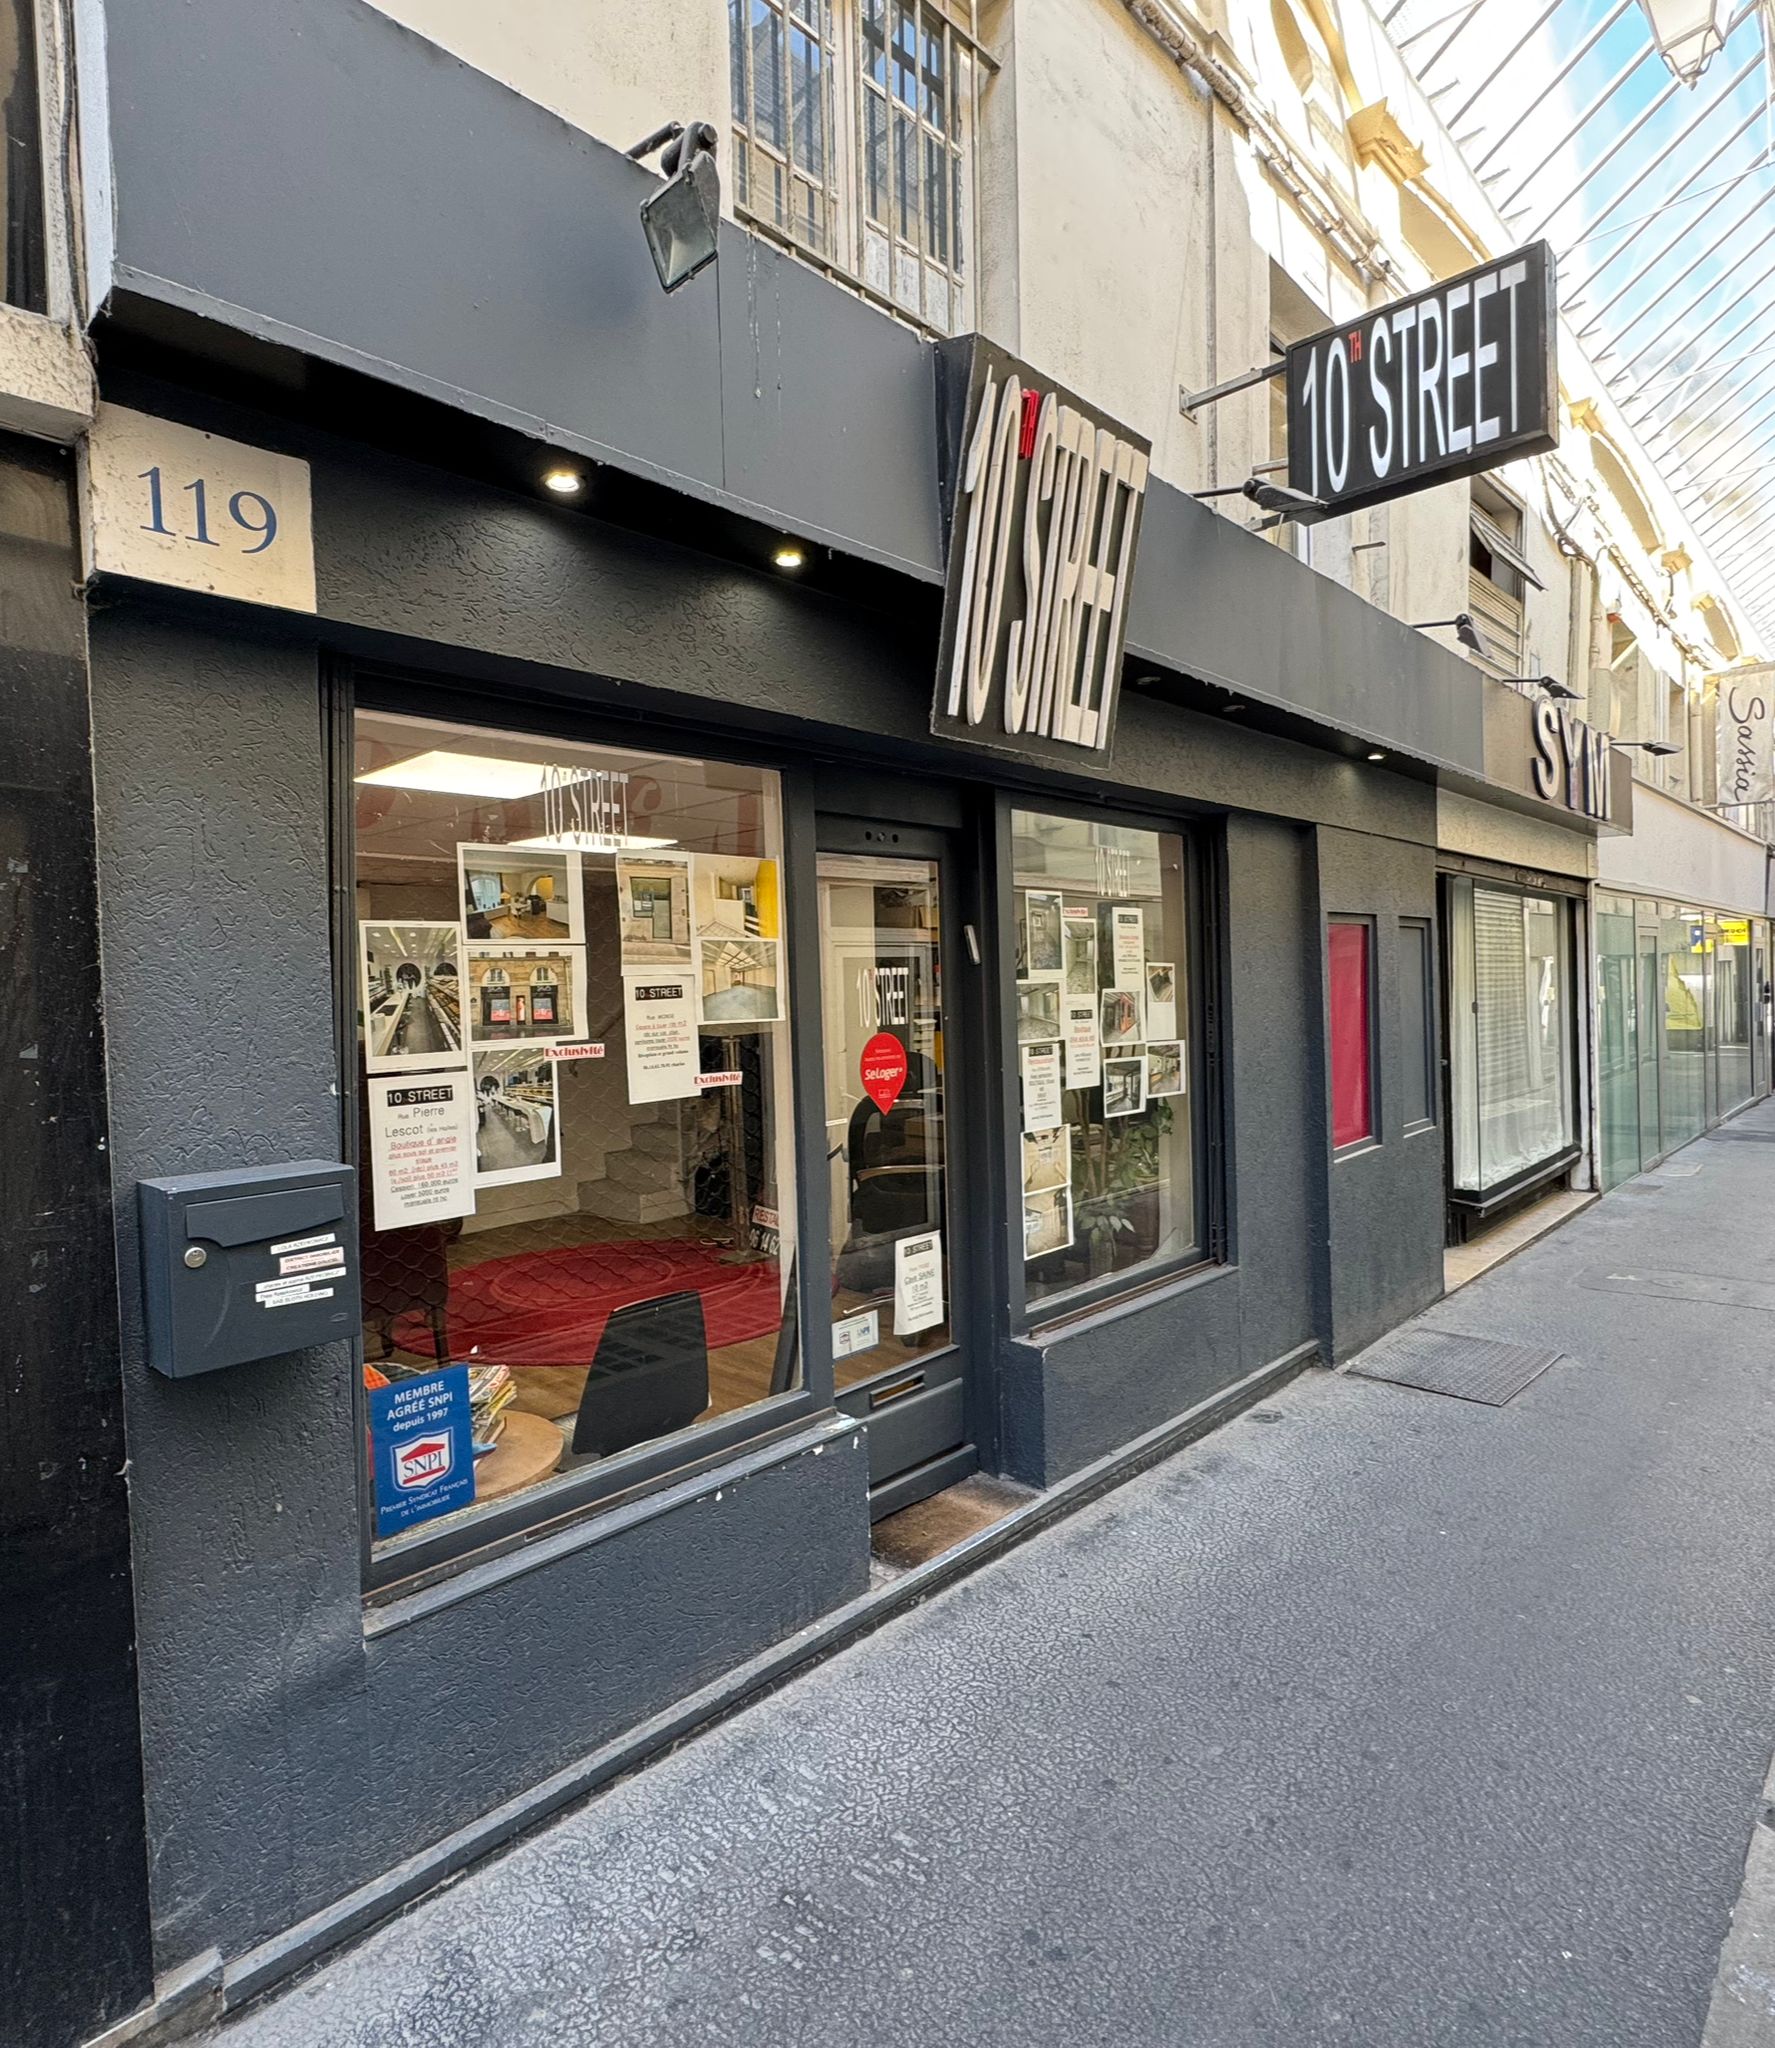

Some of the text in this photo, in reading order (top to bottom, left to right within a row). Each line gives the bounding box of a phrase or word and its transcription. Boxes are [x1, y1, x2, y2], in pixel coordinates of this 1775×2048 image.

[1369, 260, 1527, 478] STREET
[137, 466, 278, 554] 119
[1004, 391, 1149, 750] STREET
[1728, 686, 1765, 802] Sassia
[1531, 695, 1611, 821] SYM
[570, 765, 629, 846] STREET
[649, 987, 683, 998] STREET
[874, 967, 908, 1026] STREET
[545, 1046, 604, 1057] Exclusivité
[694, 1073, 740, 1084] Exclusivité
[387, 1087, 453, 1104] 10 STREET
[413, 1106, 445, 1118] Pierre
[385, 1124, 423, 1138] Lescot
[390, 1139, 424, 1151] Boutique
[437, 1136, 457, 1145] angle
[760, 1232, 770, 1251] 14
[394, 1380, 445, 1405] MEMBRE
[386, 1391, 453, 1421] AGRÉÉ SNPI
[392, 1407, 449, 1433] depuis 1997
[403, 1450, 443, 1479] SNPI
